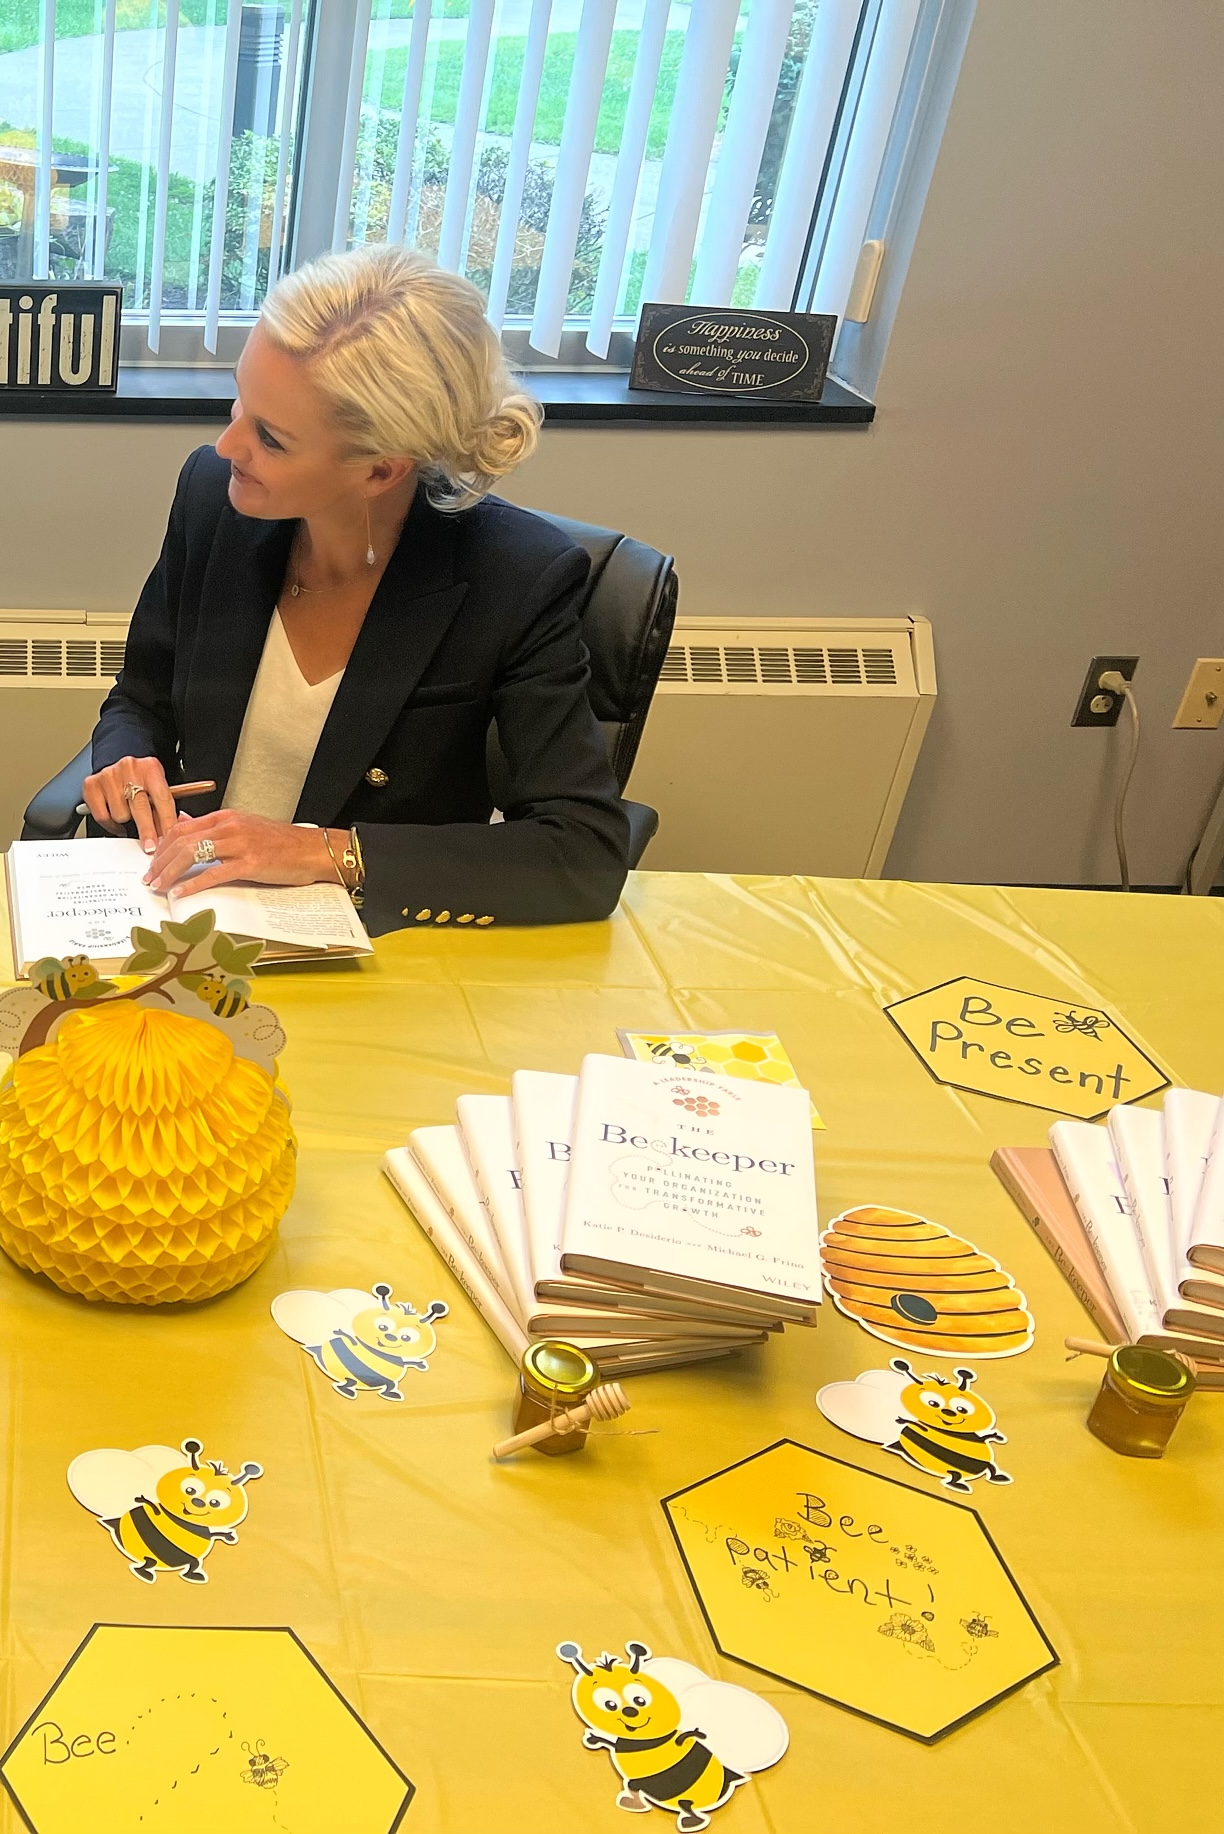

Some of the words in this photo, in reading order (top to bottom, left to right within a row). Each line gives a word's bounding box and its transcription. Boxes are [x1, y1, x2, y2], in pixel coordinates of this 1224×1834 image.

[687, 320, 783, 344] Happiness
[662, 343, 677, 353] is
[678, 343, 734, 360] something
[732, 349, 763, 364] you
[764, 348, 799, 364] decide
[679, 362, 715, 377] ahead
[717, 365, 736, 382] of
[731, 372, 765, 386] TIME
[46, 906, 144, 918] Beekeeper
[959, 996, 1046, 1038] Be
[661, 1076, 715, 1087] LEADERSHIP
[717, 1085, 742, 1101] FABLE
[676, 1124, 715, 1136] THE
[598, 1123, 796, 1176] Beekeeper
[623, 1171, 656, 1184] YOUR
[663, 1180, 762, 1205] ORGANIZATION
[645, 1187, 766, 1217] TRANSFORMATIVE
[582, 1220, 614, 1231] Katie
[630, 1228, 683, 1245] Desiderio
[707, 1244, 752, 1259] Michael
[772, 1256, 805, 1270] Frino
[761, 1274, 812, 1292] WILEY
[796, 1492, 889, 1545] Bee
[30, 1721, 117, 1766] Bee
